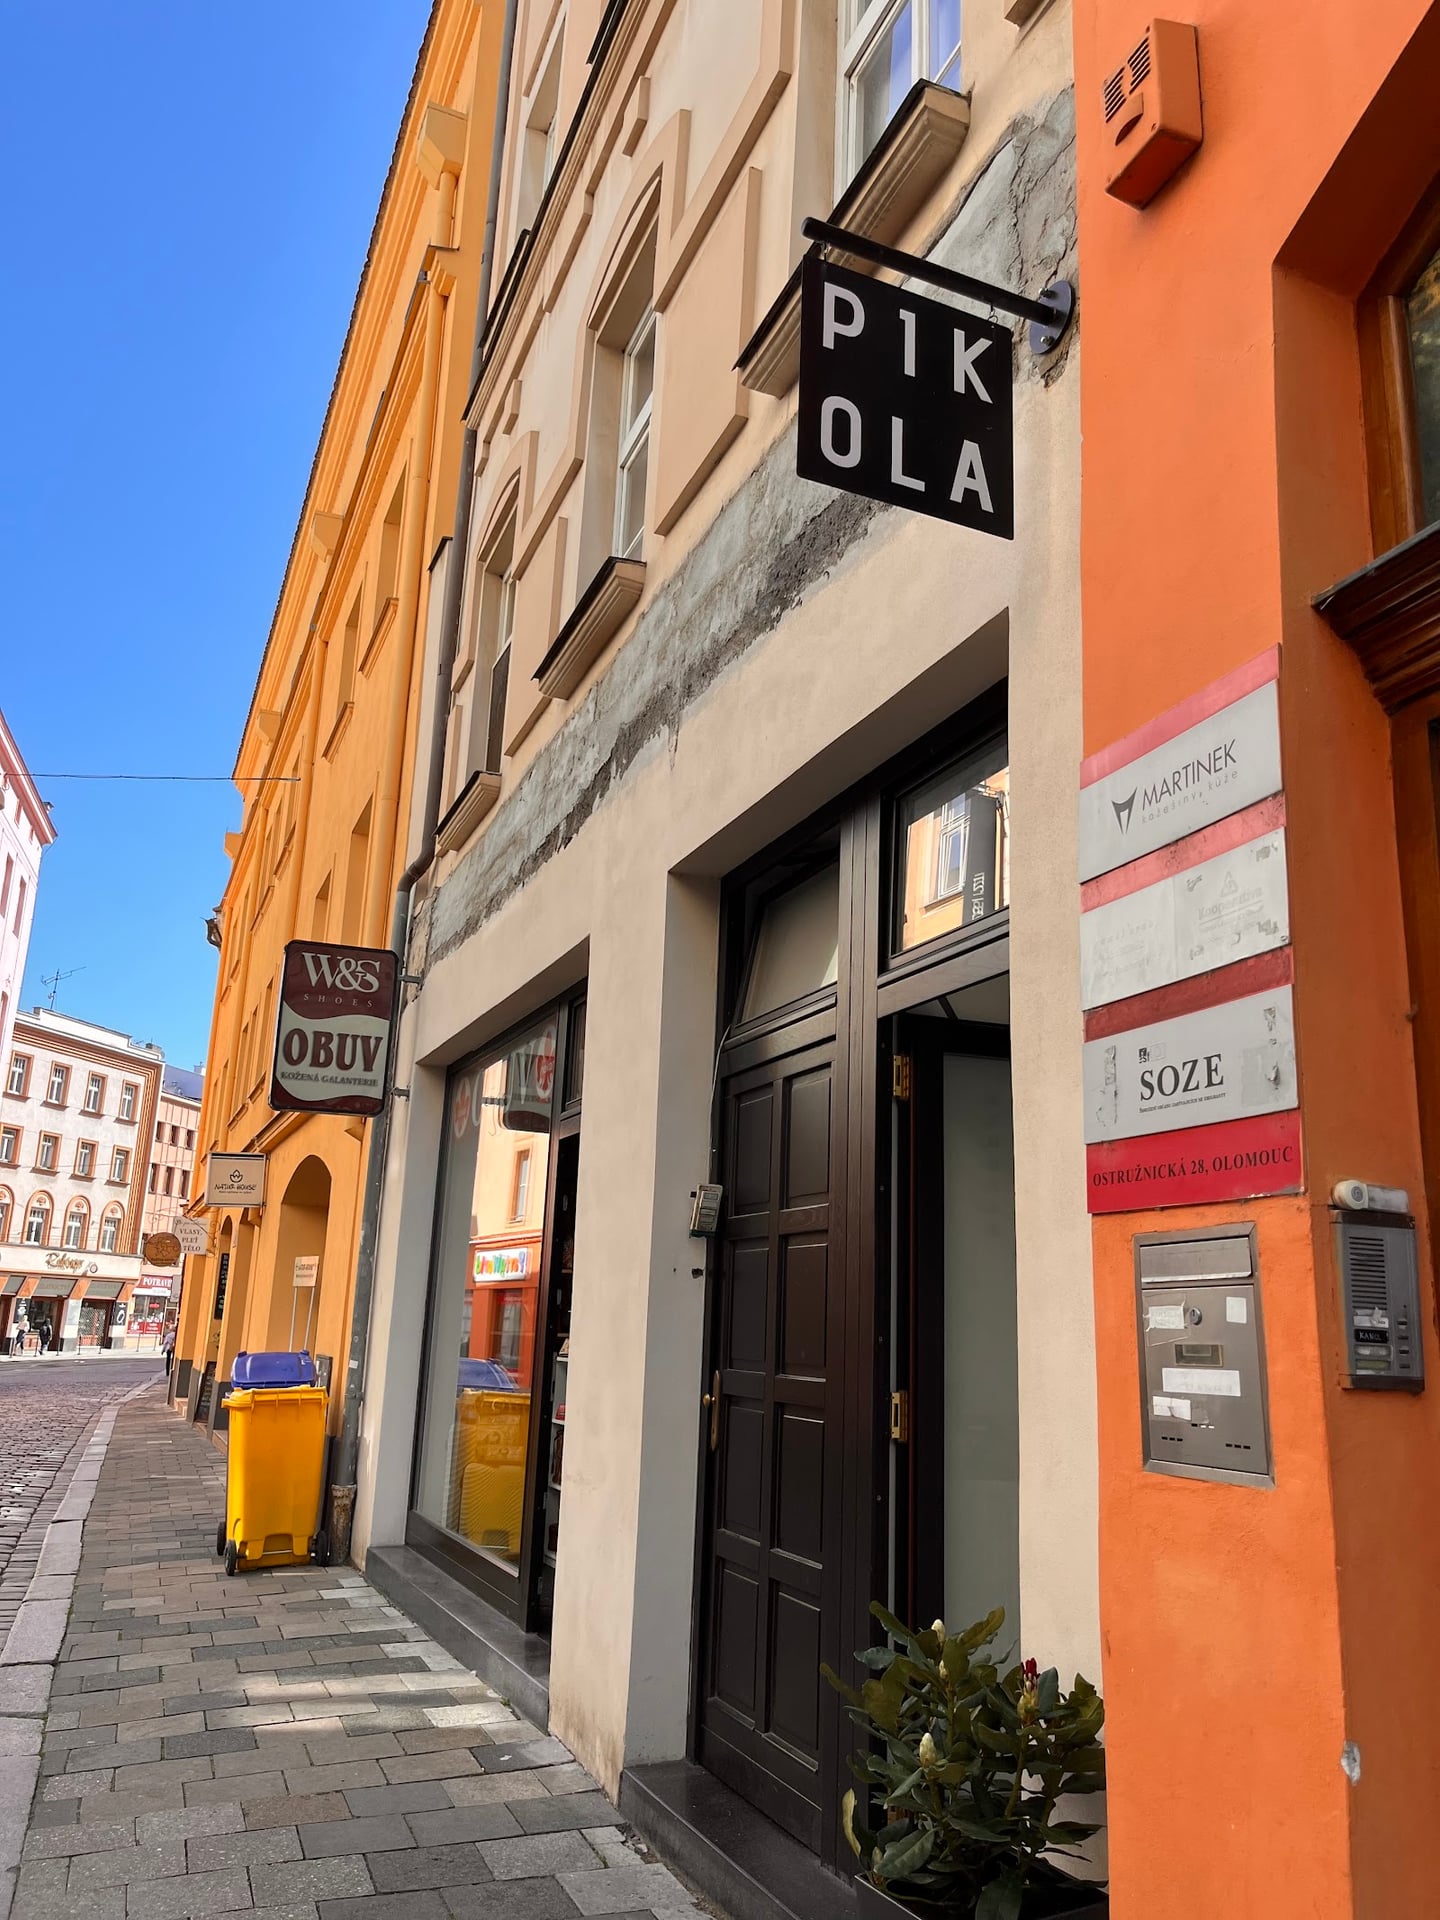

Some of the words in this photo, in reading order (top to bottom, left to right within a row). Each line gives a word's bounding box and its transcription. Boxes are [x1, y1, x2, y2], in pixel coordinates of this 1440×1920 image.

[1142, 738, 1237, 811] MARTINEK
[302, 952, 381, 993] W&S
[303, 993, 374, 1007] SHOES
[283, 1028, 384, 1072] OBUV
[280, 1071, 320, 1083] KOŽENÁ
[321, 1074, 379, 1087] GALANTERIE
[1140, 1053, 1224, 1102] SOZE
[1093, 1157, 1186, 1186] OSTRUŽNICKÁ
[1191, 1159, 1209, 1176] 28,
[1213, 1146, 1294, 1172] OLOMOUC
